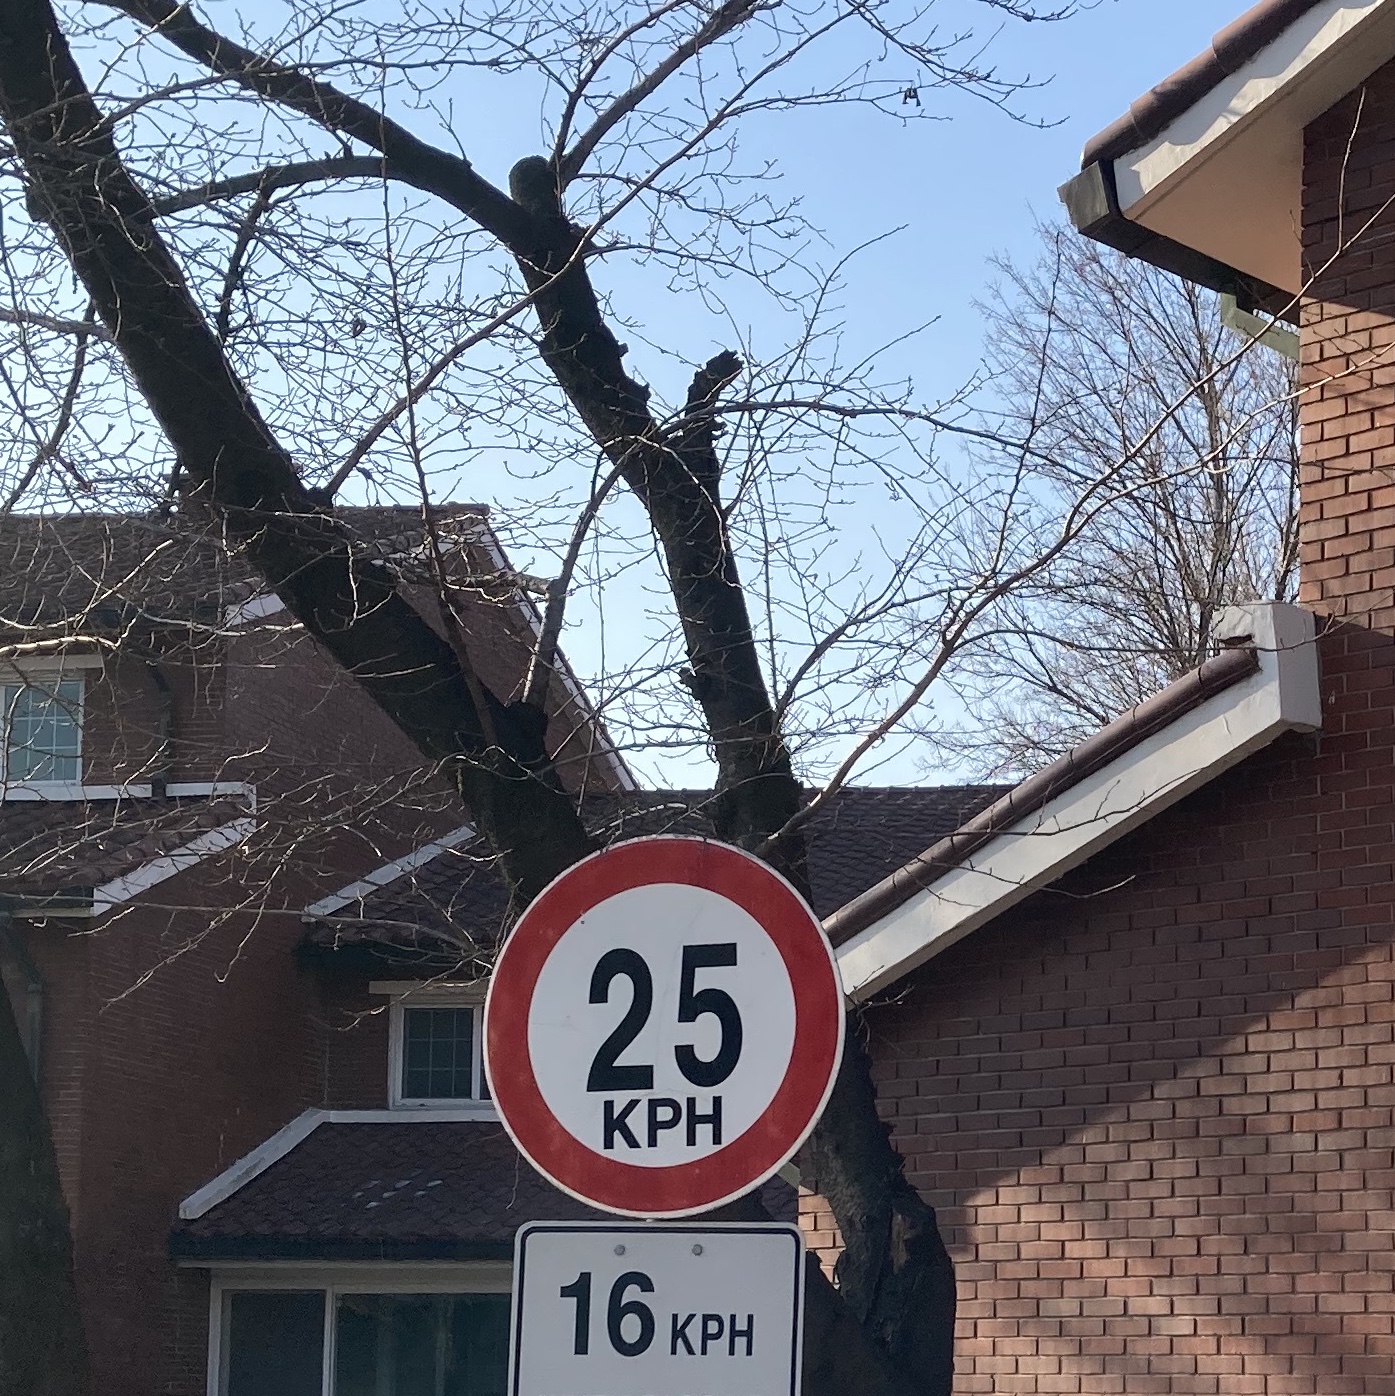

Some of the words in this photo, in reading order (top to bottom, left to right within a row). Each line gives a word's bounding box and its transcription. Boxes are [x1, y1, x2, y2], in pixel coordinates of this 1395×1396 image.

[587, 943, 743, 1092] 25
[603, 1096, 723, 1150] KPH
[559, 1271, 656, 1358] 16
[670, 1312, 754, 1357] KPH
